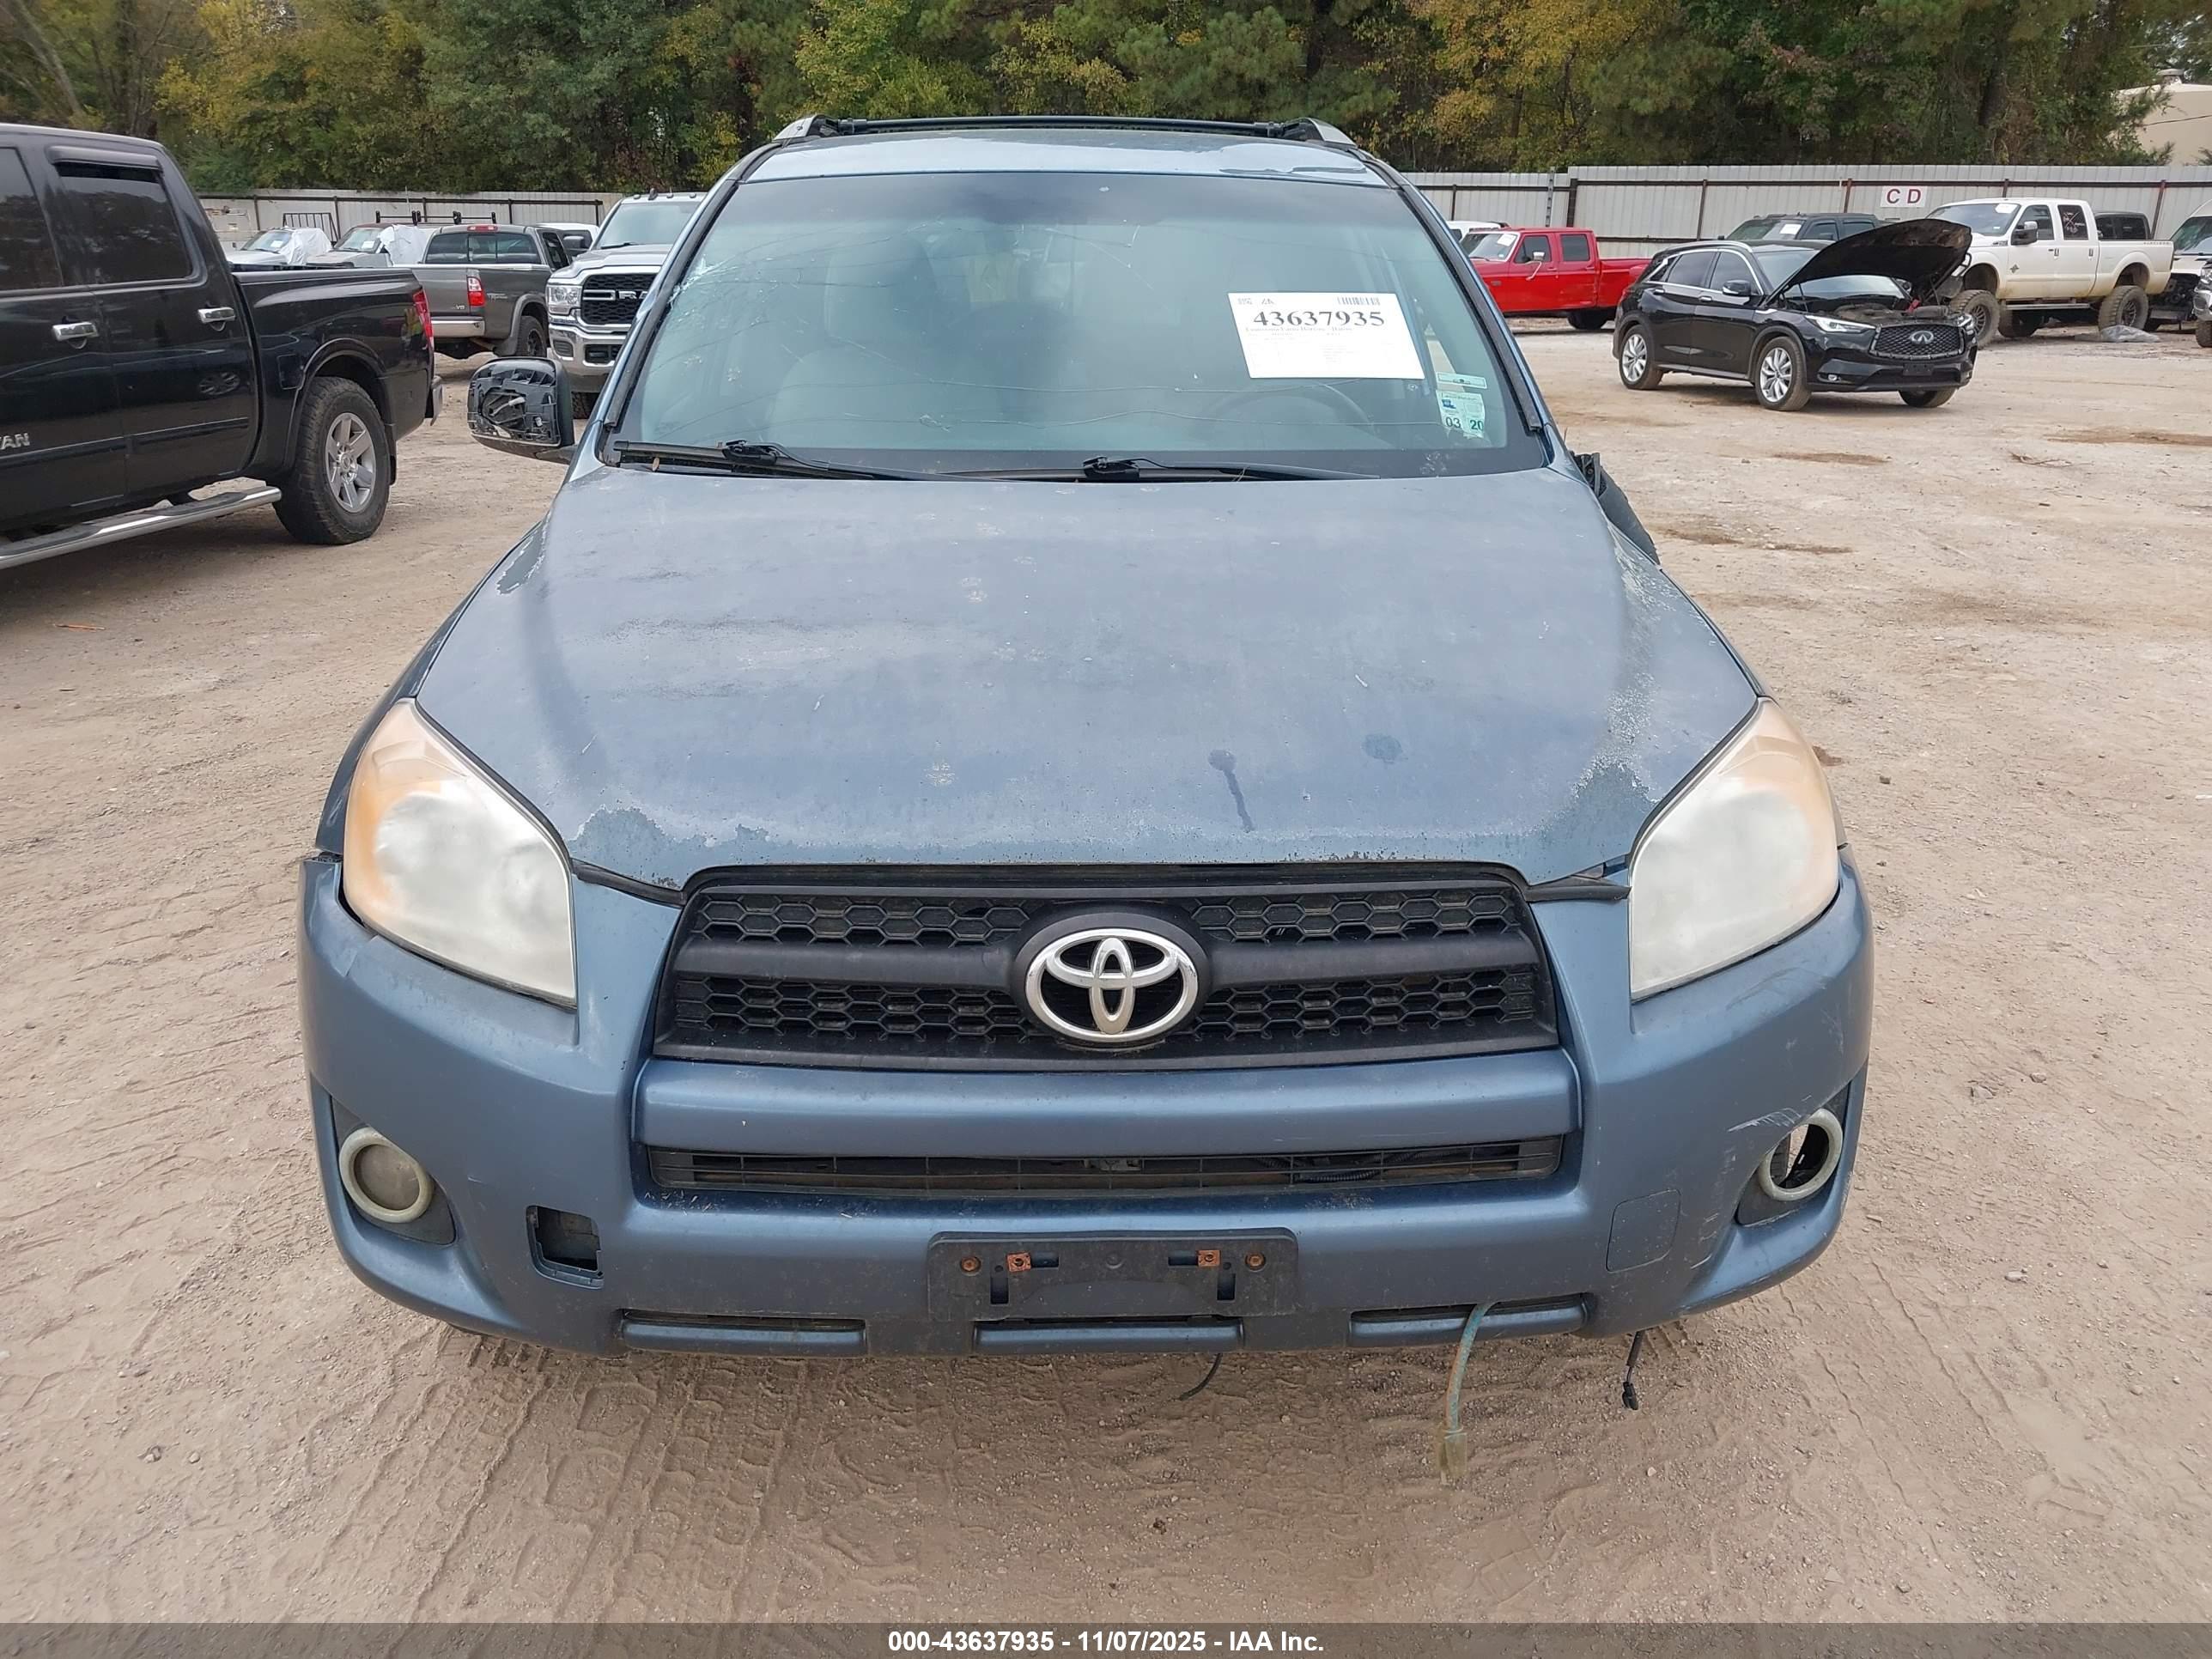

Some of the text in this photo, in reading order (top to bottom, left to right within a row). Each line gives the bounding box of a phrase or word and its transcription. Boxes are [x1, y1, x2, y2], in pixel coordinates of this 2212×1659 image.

[1887, 188, 1922, 204] C D
[1253, 310, 1385, 326] 43637935
[1445, 416, 1484, 432] 03 20
[0, 433, 30, 450] AN
